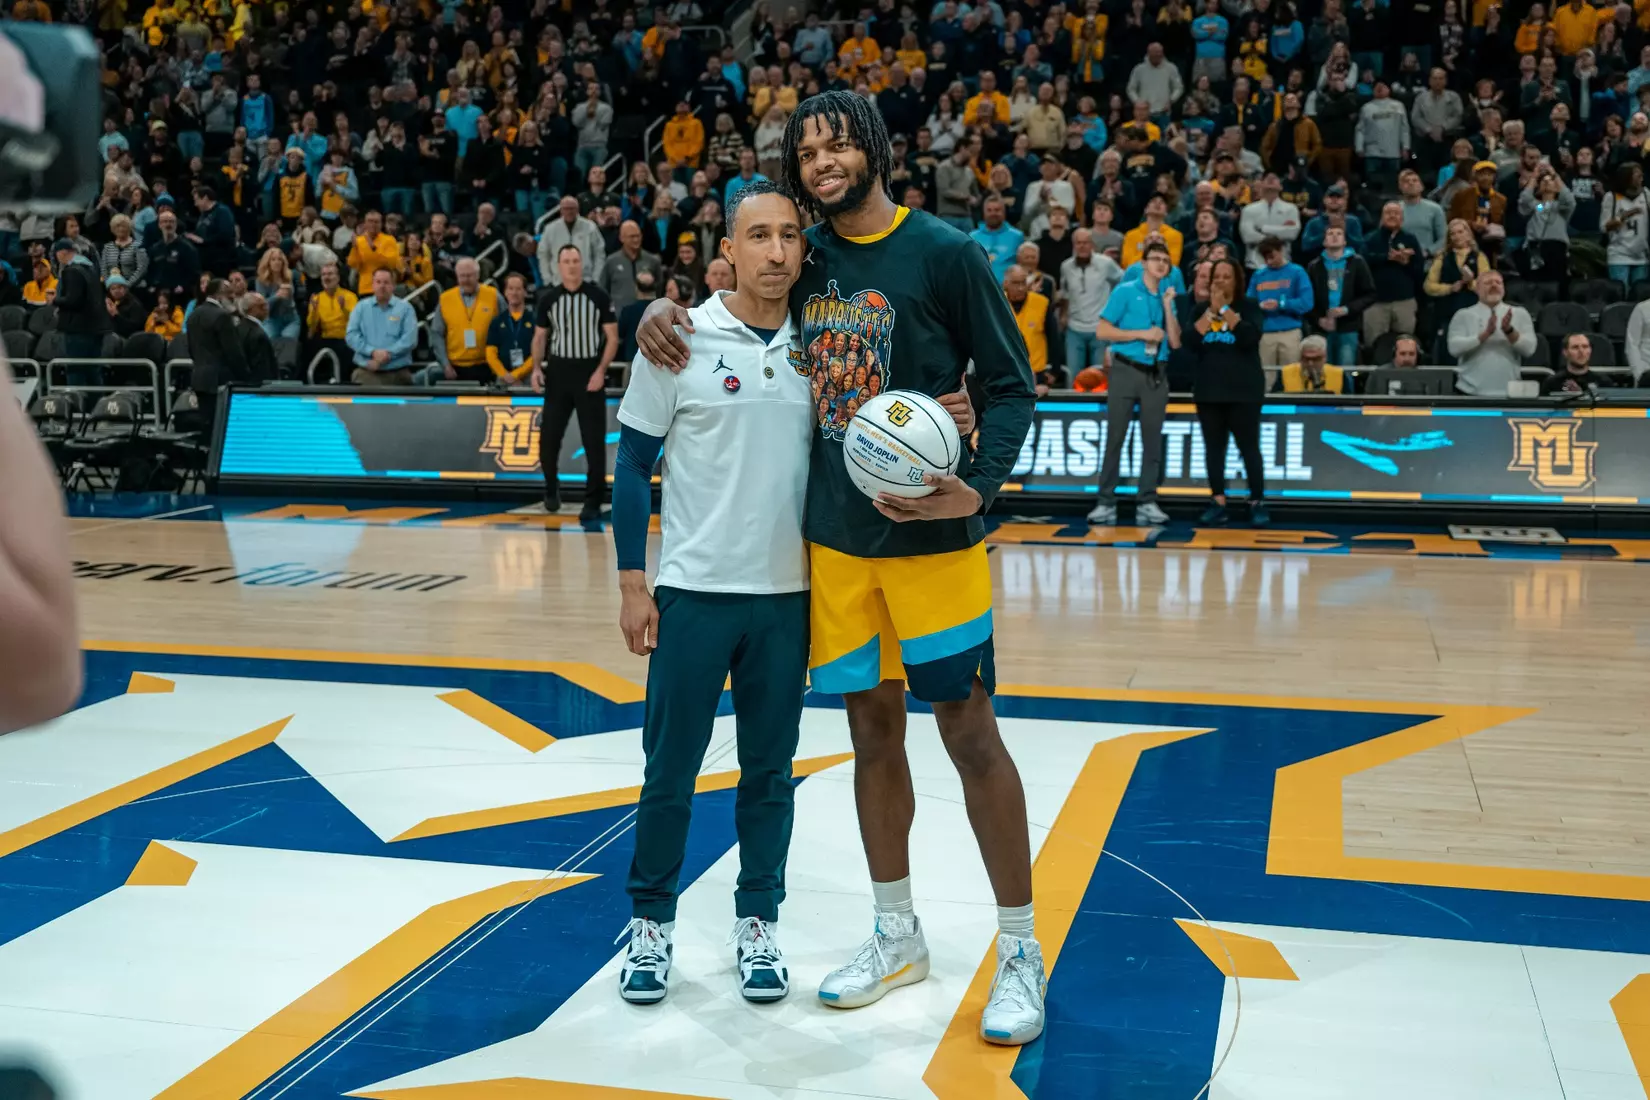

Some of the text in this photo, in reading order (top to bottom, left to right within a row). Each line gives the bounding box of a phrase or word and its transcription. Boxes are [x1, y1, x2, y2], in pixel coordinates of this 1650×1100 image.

[804, 300, 892, 337] MARQUETTE
[885, 400, 914, 428] MU
[479, 406, 543, 471] MU
[856, 433, 874, 450] DAVID
[873, 446, 900, 464] JOPLIN
[887, 441, 922, 466] BASKETBALL
[1010, 419, 1312, 481] BASTALL
[1507, 418, 1599, 492] MU
[907, 466, 924, 483] MU
